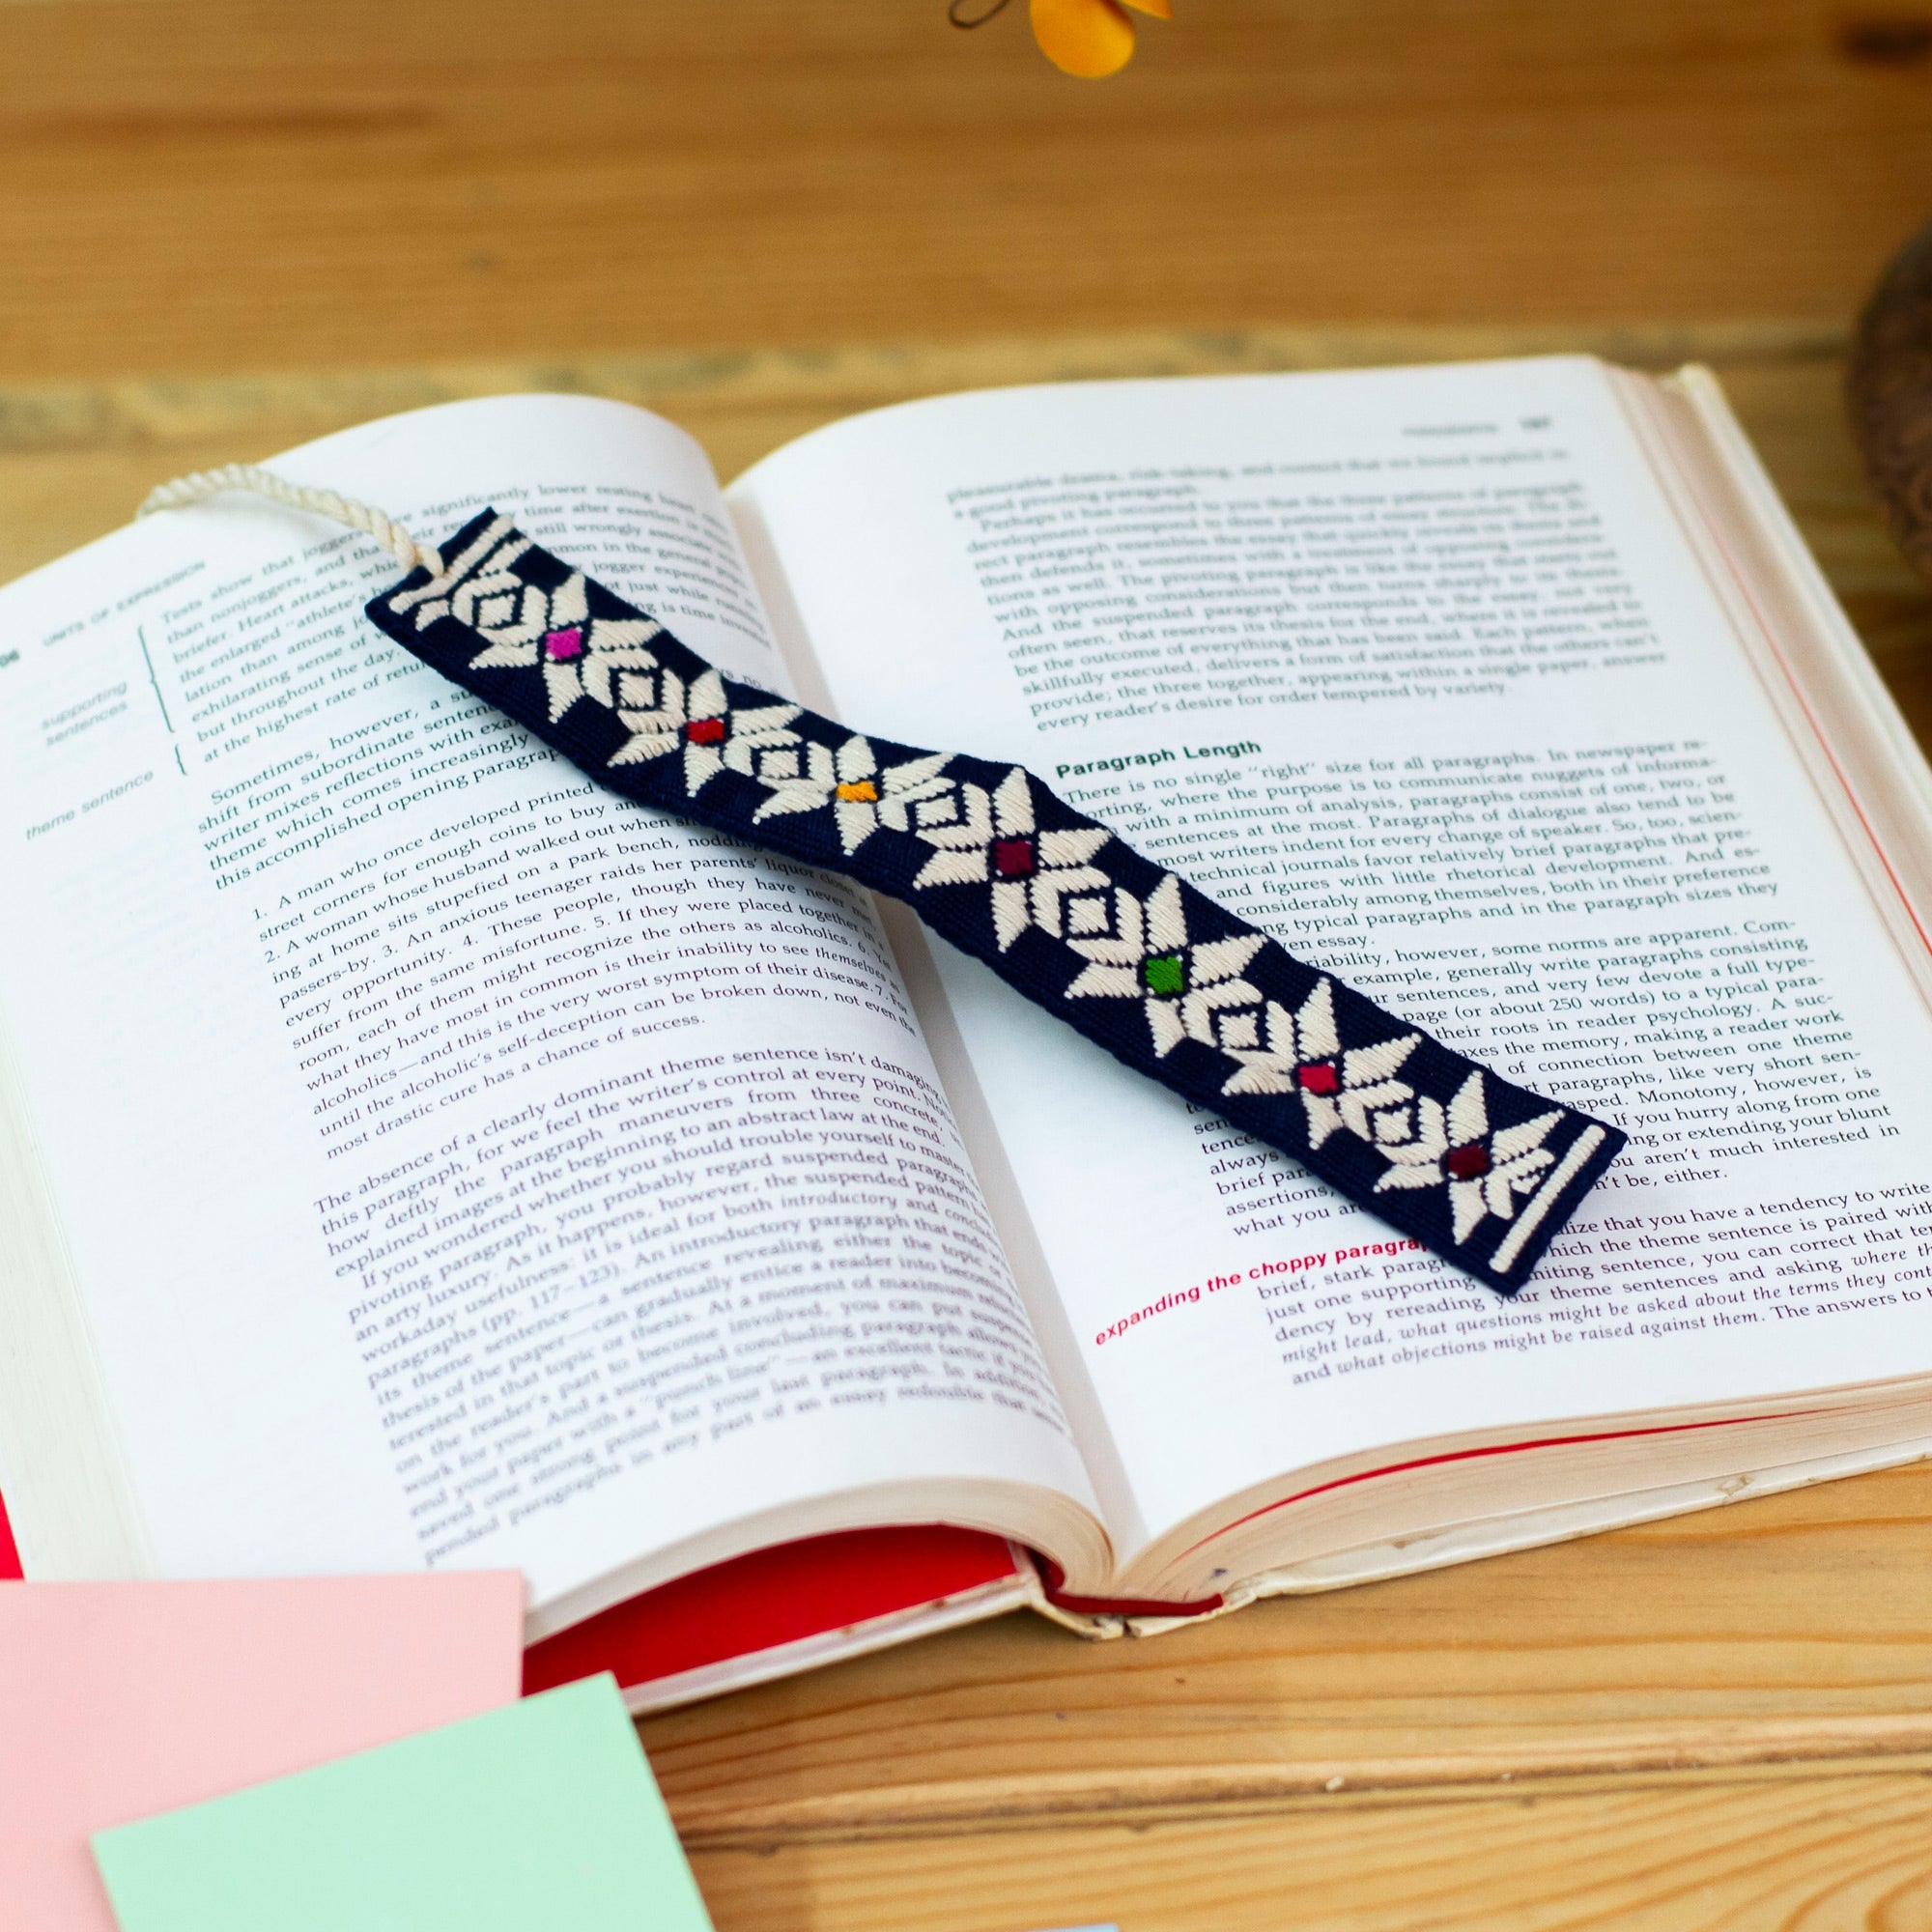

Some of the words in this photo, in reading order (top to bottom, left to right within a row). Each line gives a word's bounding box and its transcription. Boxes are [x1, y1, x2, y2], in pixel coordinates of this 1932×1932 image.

[196, 721, 225, 742] but
[230, 675, 325, 726] throughout
[329, 664, 357, 680] the
[363, 639, 402, 667] day.
[203, 748, 218, 763] at
[223, 734, 250, 753] the
[255, 701, 319, 737] highest
[325, 686, 355, 706] rate
[361, 673, 379, 690] of
[384, 658, 429, 682] retur
[1036, 712, 1089, 731] every
[1094, 699, 1171, 721] reader's
[1175, 696, 1233, 711] desire
[1236, 693, 1264, 706] for
[1267, 689, 1318, 703] order
[1321, 683, 1410, 703] tempered
[1412, 683, 1437, 698] by
[1442, 681, 1505, 696] variety
[197, 805, 239, 833] shift
[247, 782, 292, 810] from
[299, 729, 413, 784] subordinate
[203, 818, 259, 851] writer
[265, 791, 320, 823] mixes
[325, 748, 423, 795] reflections
[428, 727, 473, 752] with
[210, 751, 319, 805] Sometimes,
[328, 708, 418, 750] however,
[429, 699, 440, 710] a
[1055, 748, 1176, 779] Paragraph
[1181, 740, 1262, 759] Length
[1065, 784, 1121, 806] There
[1127, 779, 1146, 792] is
[1151, 777, 1178, 789] no
[1183, 768, 1242, 786] single
[1247, 761, 1315, 781] "right"
[1324, 760, 1362, 773] size
[1368, 757, 1395, 771] for
[1403, 755, 1425, 770] all
[1547, 749, 1569, 761] In
[1575, 742, 1675, 759] newspaper
[25, 809, 75, 840] theme
[80, 770, 154, 813] sentence
[209, 837, 266, 870] theme
[274, 805, 333, 838] which
[342, 778, 401, 809] comes
[410, 732, 527, 781] increasingly
[214, 867, 250, 890] this
[255, 803, 382, 871] accomplished
[386, 774, 469, 811] opening
[471, 748, 559, 783] paragrap
[253, 907, 267, 920] 1.
[278, 895, 291, 909] A
[297, 876, 334, 899] man
[339, 857, 377, 879] who
[383, 838, 422, 860] once
[429, 800, 521, 841] developed
[526, 776, 597, 811] printed
[1188, 860, 1277, 883] technical
[1280, 854, 1359, 875] journals
[1363, 853, 1412, 867] favor
[1418, 846, 1504, 864] relatively
[1510, 842, 1555, 858] brief
[1561, 835, 1666, 857] paragraphs
[1670, 831, 1708, 844] that
[278, 956, 375, 1008] passers-by.
[382, 944, 398, 957] 3.
[407, 929, 432, 947] An
[439, 900, 508, 933] anxious
[514, 874, 592, 904] teenager
[599, 862, 645, 881] raids
[651, 859, 682, 871] her
[689, 857, 756, 869] parents'
[1401, 1010, 1447, 1027] page
[1454, 1005, 1481, 1020] (or
[1490, 1001, 1545, 1016] about
[1548, 996, 1582, 1010] 250
[1589, 990, 1655, 1008] words)
[1662, 989, 1681, 1001] to
[1689, 989, 1698, 999] a
[1704, 978, 1769, 1000] typical
[1775, 977, 1825, 993] para-
[326, 1131, 369, 1159] most
[375, 1102, 433, 1136] drastic
[439, 1084, 476, 1106] cure
[482, 1068, 514, 1088] has
[521, 1062, 530, 1072] a
[536, 1038, 599, 1066] chance
[606, 1026, 623, 1042] of
[631, 1015, 704, 1037] success.
[1612, 1112, 1627, 1125] If
[1633, 1112, 1671, 1126] you
[1674, 1106, 1728, 1121] hurry
[1736, 1099, 1791, 1114] along
[1793, 1094, 1840, 1107] from
[1845, 1088, 1880, 1100] one
[313, 1191, 351, 1213] The
[357, 1151, 433, 1194] absence
[440, 1135, 458, 1155] of
[466, 1133, 476, 1144] a
[482, 1103, 545, 1136] clearly
[554, 1066, 654, 1107] dominant
[660, 1055, 724, 1075] theme
[731, 1047, 818, 1063] sentence
[824, 1047, 866, 1065] isn't
[1209, 1152, 1279, 1175] always
[361, 1269, 377, 1289] If
[381, 1255, 418, 1283] you
[422, 1203, 523, 1259] wondered
[527, 1172, 611, 1211] whether
[616, 1158, 657, 1182] you
[661, 1136, 733, 1165] should
[738, 1127, 813, 1148] trouble
[817, 1130, 895, 1147] yourself
[898, 1136, 916, 1151] to
[1216, 1171, 1264, 1195] brief
[1225, 1186, 1334, 1216] assertions,
[1623, 1173, 1657, 1188] be,
[1663, 1167, 1727, 1183] either.
[1233, 1213, 1285, 1236] what
[1291, 1208, 1330, 1227] you
[1599, 1238, 1631, 1252] the
[1638, 1234, 1700, 1248] theme
[1707, 1223, 1792, 1241] sentence
[1799, 1218, 1817, 1231] is
[1824, 1207, 1888, 1231] paired
[1095, 1286, 1200, 1345] expanding
[1207, 1273, 1241, 1292] the
[1248, 1252, 1326, 1279] choppy
[1256, 1274, 1315, 1299] brief,
[1323, 1264, 1374, 1285] stark
[1293, 1362, 1331, 1384] and
[1337, 1353, 1384, 1374] what
[1391, 1341, 1487, 1363] objections
[1492, 1331, 1546, 1349] might
[1550, 1328, 1572, 1343] be
[1579, 1321, 1634, 1340] raised
[1639, 1316, 1706, 1336] against
[1712, 1311, 1765, 1326] them.
[1769, 1304, 1810, 1319] The
[1815, 1293, 1897, 1314] answers
[1901, 1290, 1921, 1301] to
